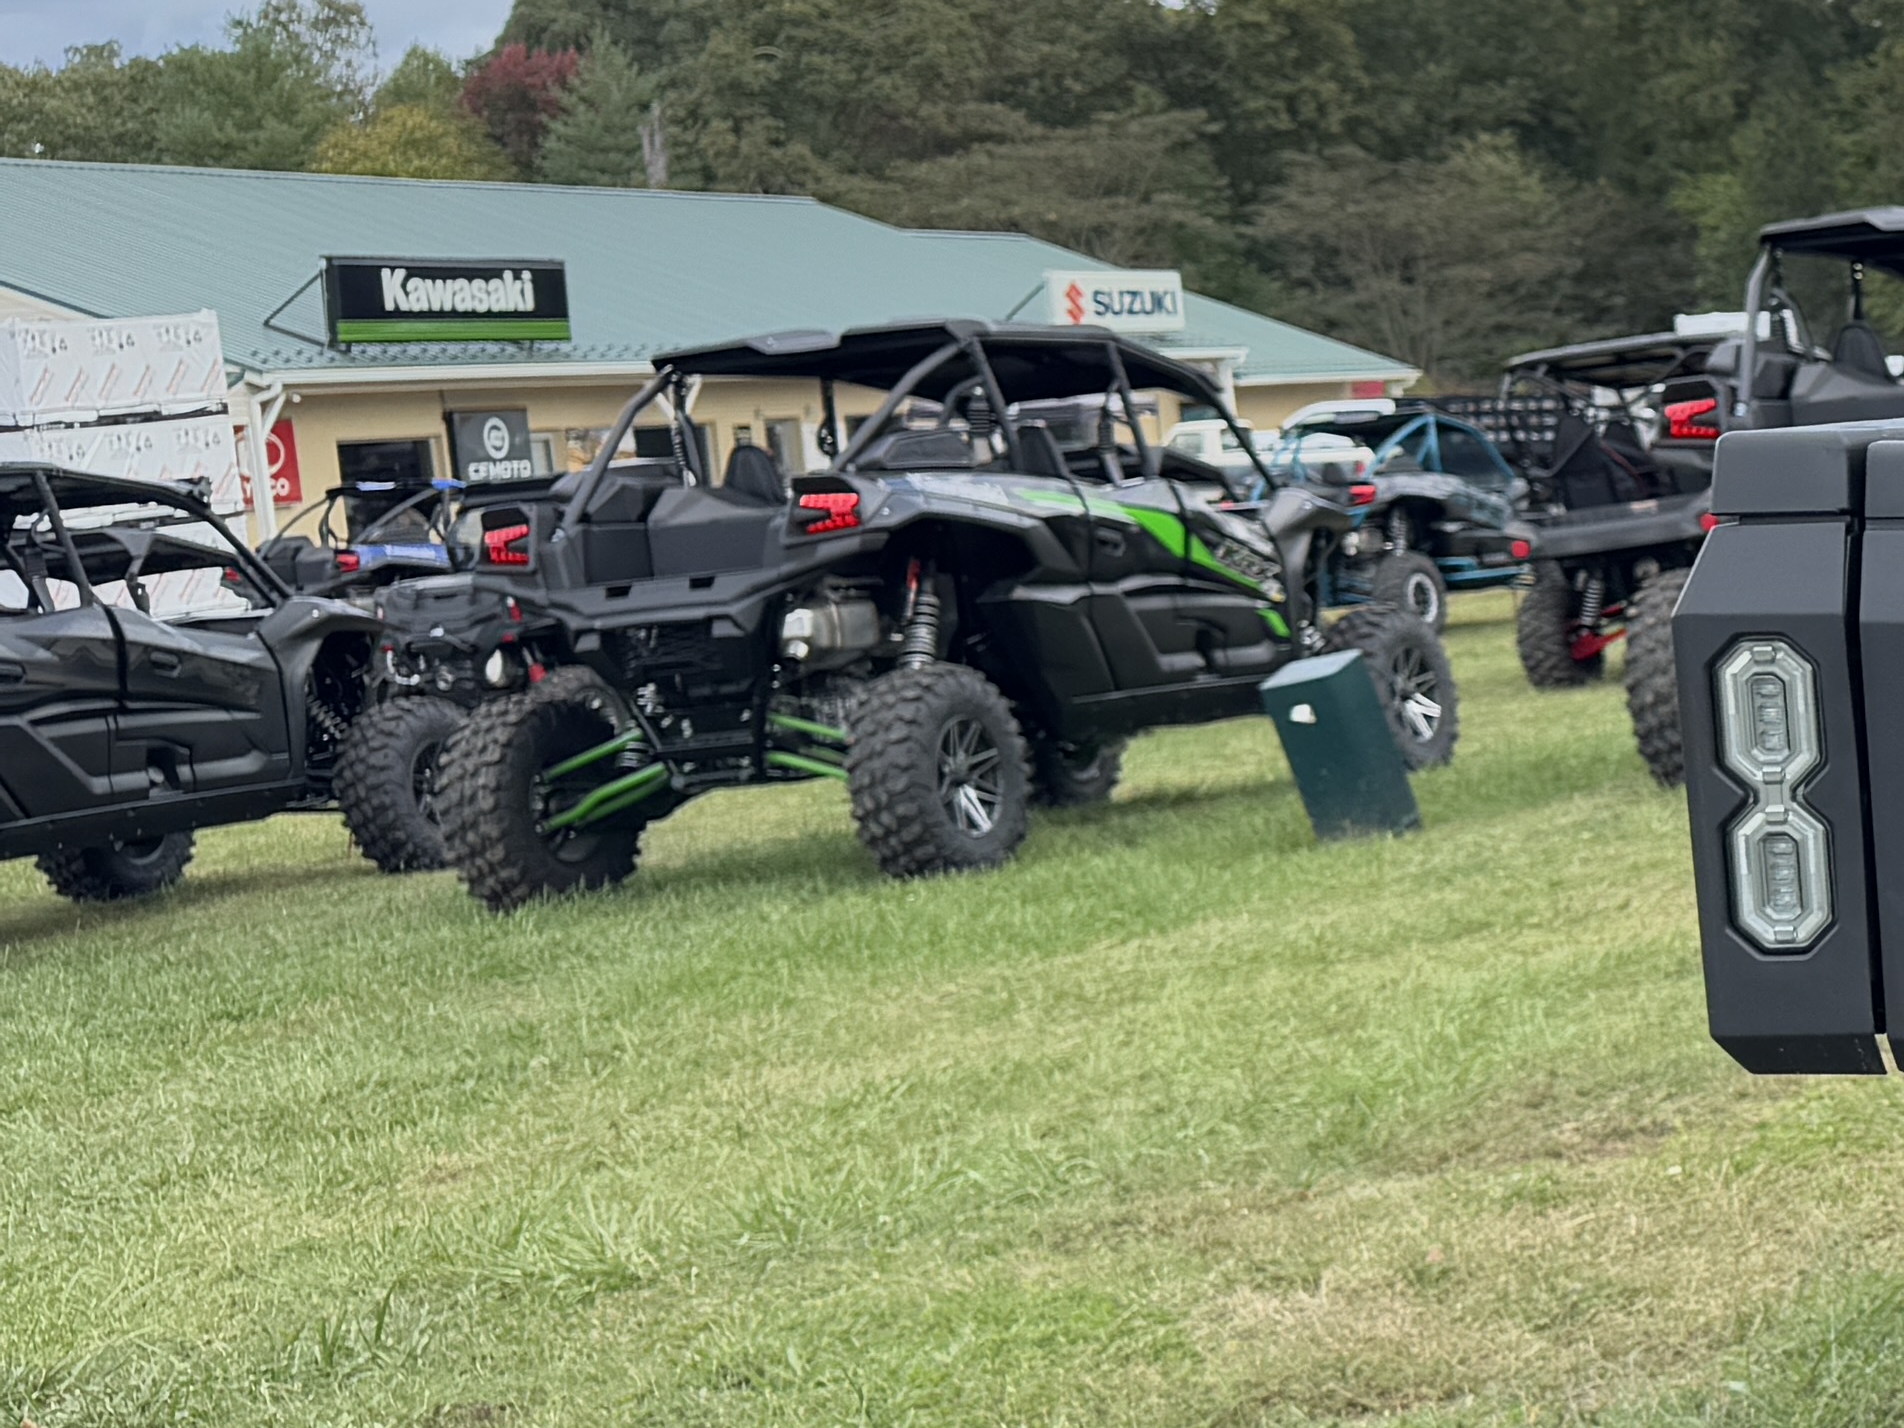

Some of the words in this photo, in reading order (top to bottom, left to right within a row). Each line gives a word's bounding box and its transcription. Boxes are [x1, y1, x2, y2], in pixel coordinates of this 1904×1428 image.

[381, 267, 535, 313] Kawasaki
[1092, 289, 1178, 315] SUZUKI
[468, 459, 532, 481] CFMOTO
